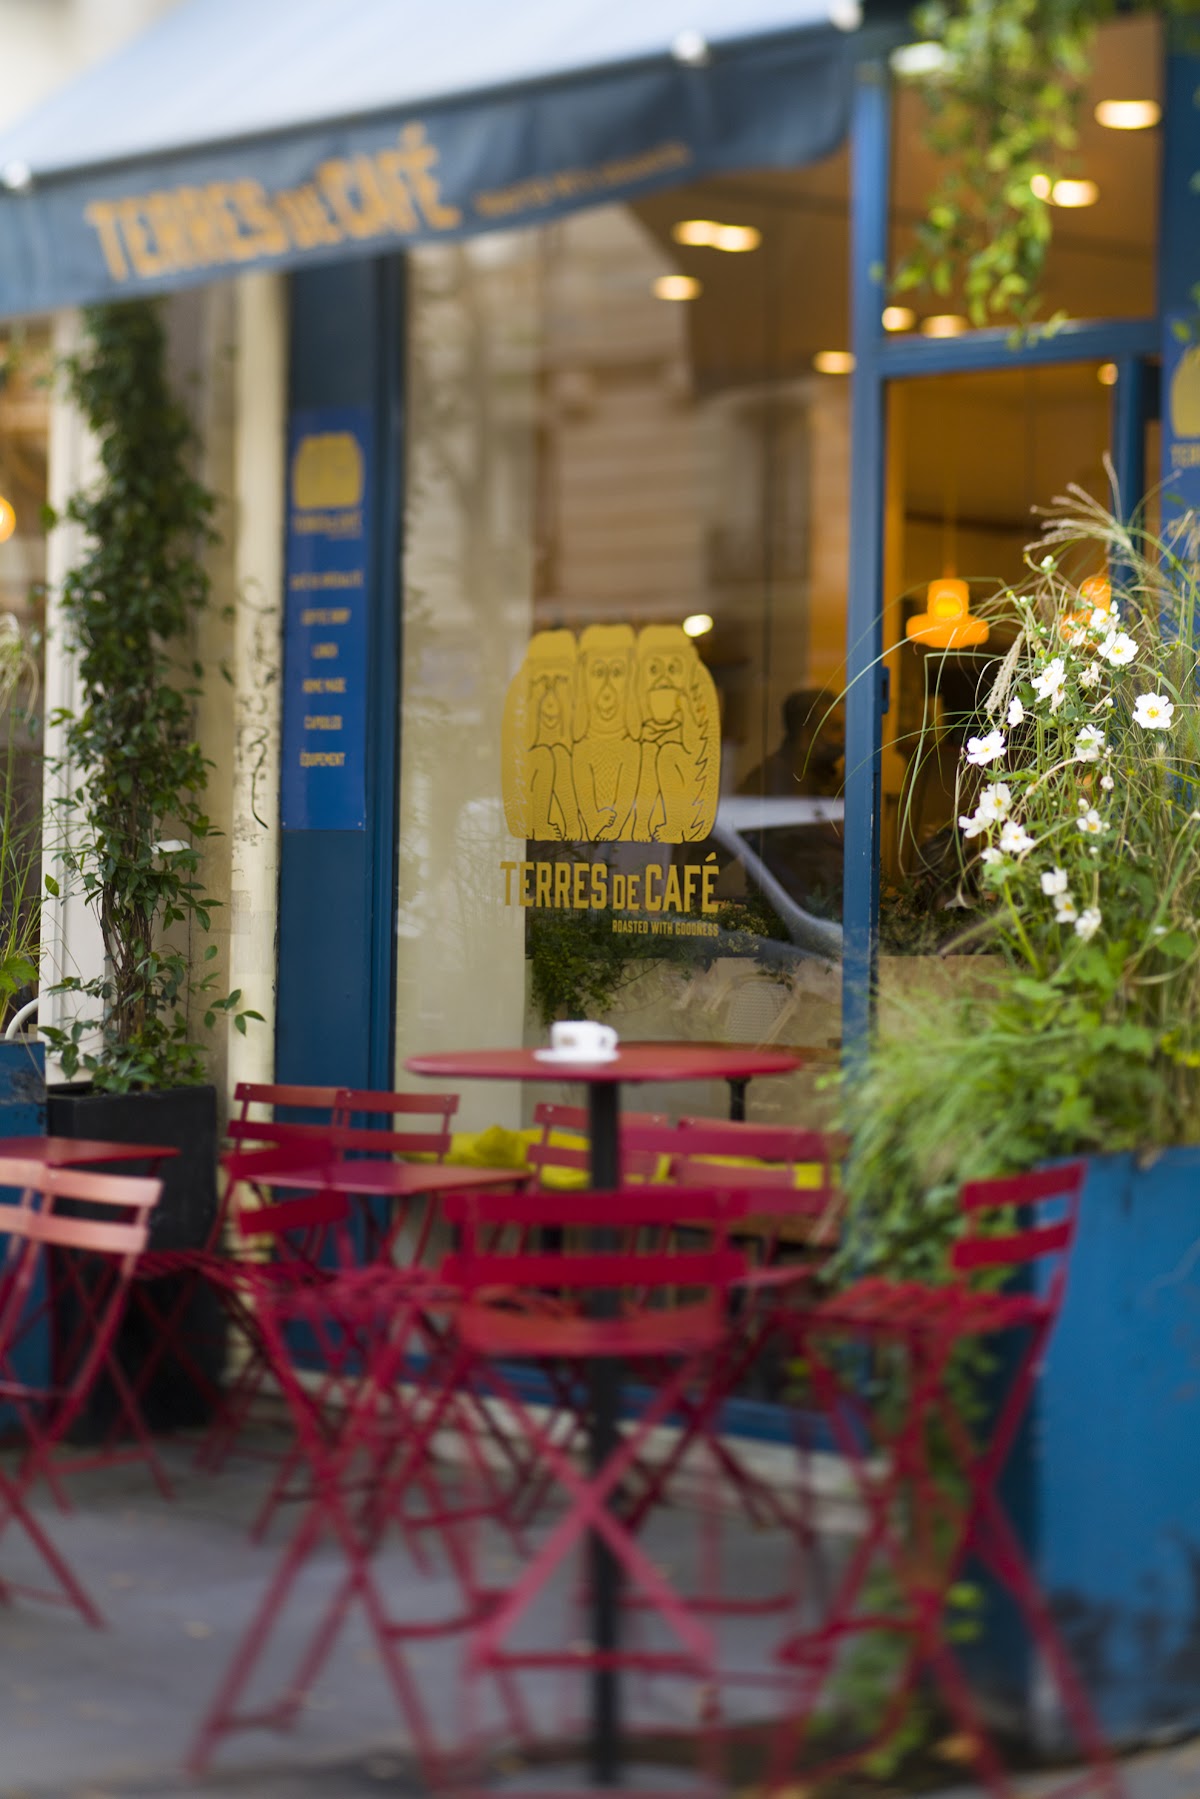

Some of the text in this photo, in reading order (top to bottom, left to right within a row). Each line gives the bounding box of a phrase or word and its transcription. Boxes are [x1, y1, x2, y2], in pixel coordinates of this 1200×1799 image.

[85, 176, 289, 282] TERRES
[500, 852, 719, 913] TERRES DE CAFÉ
[612, 919, 719, 937] ROASTED WITH GOODNESS
